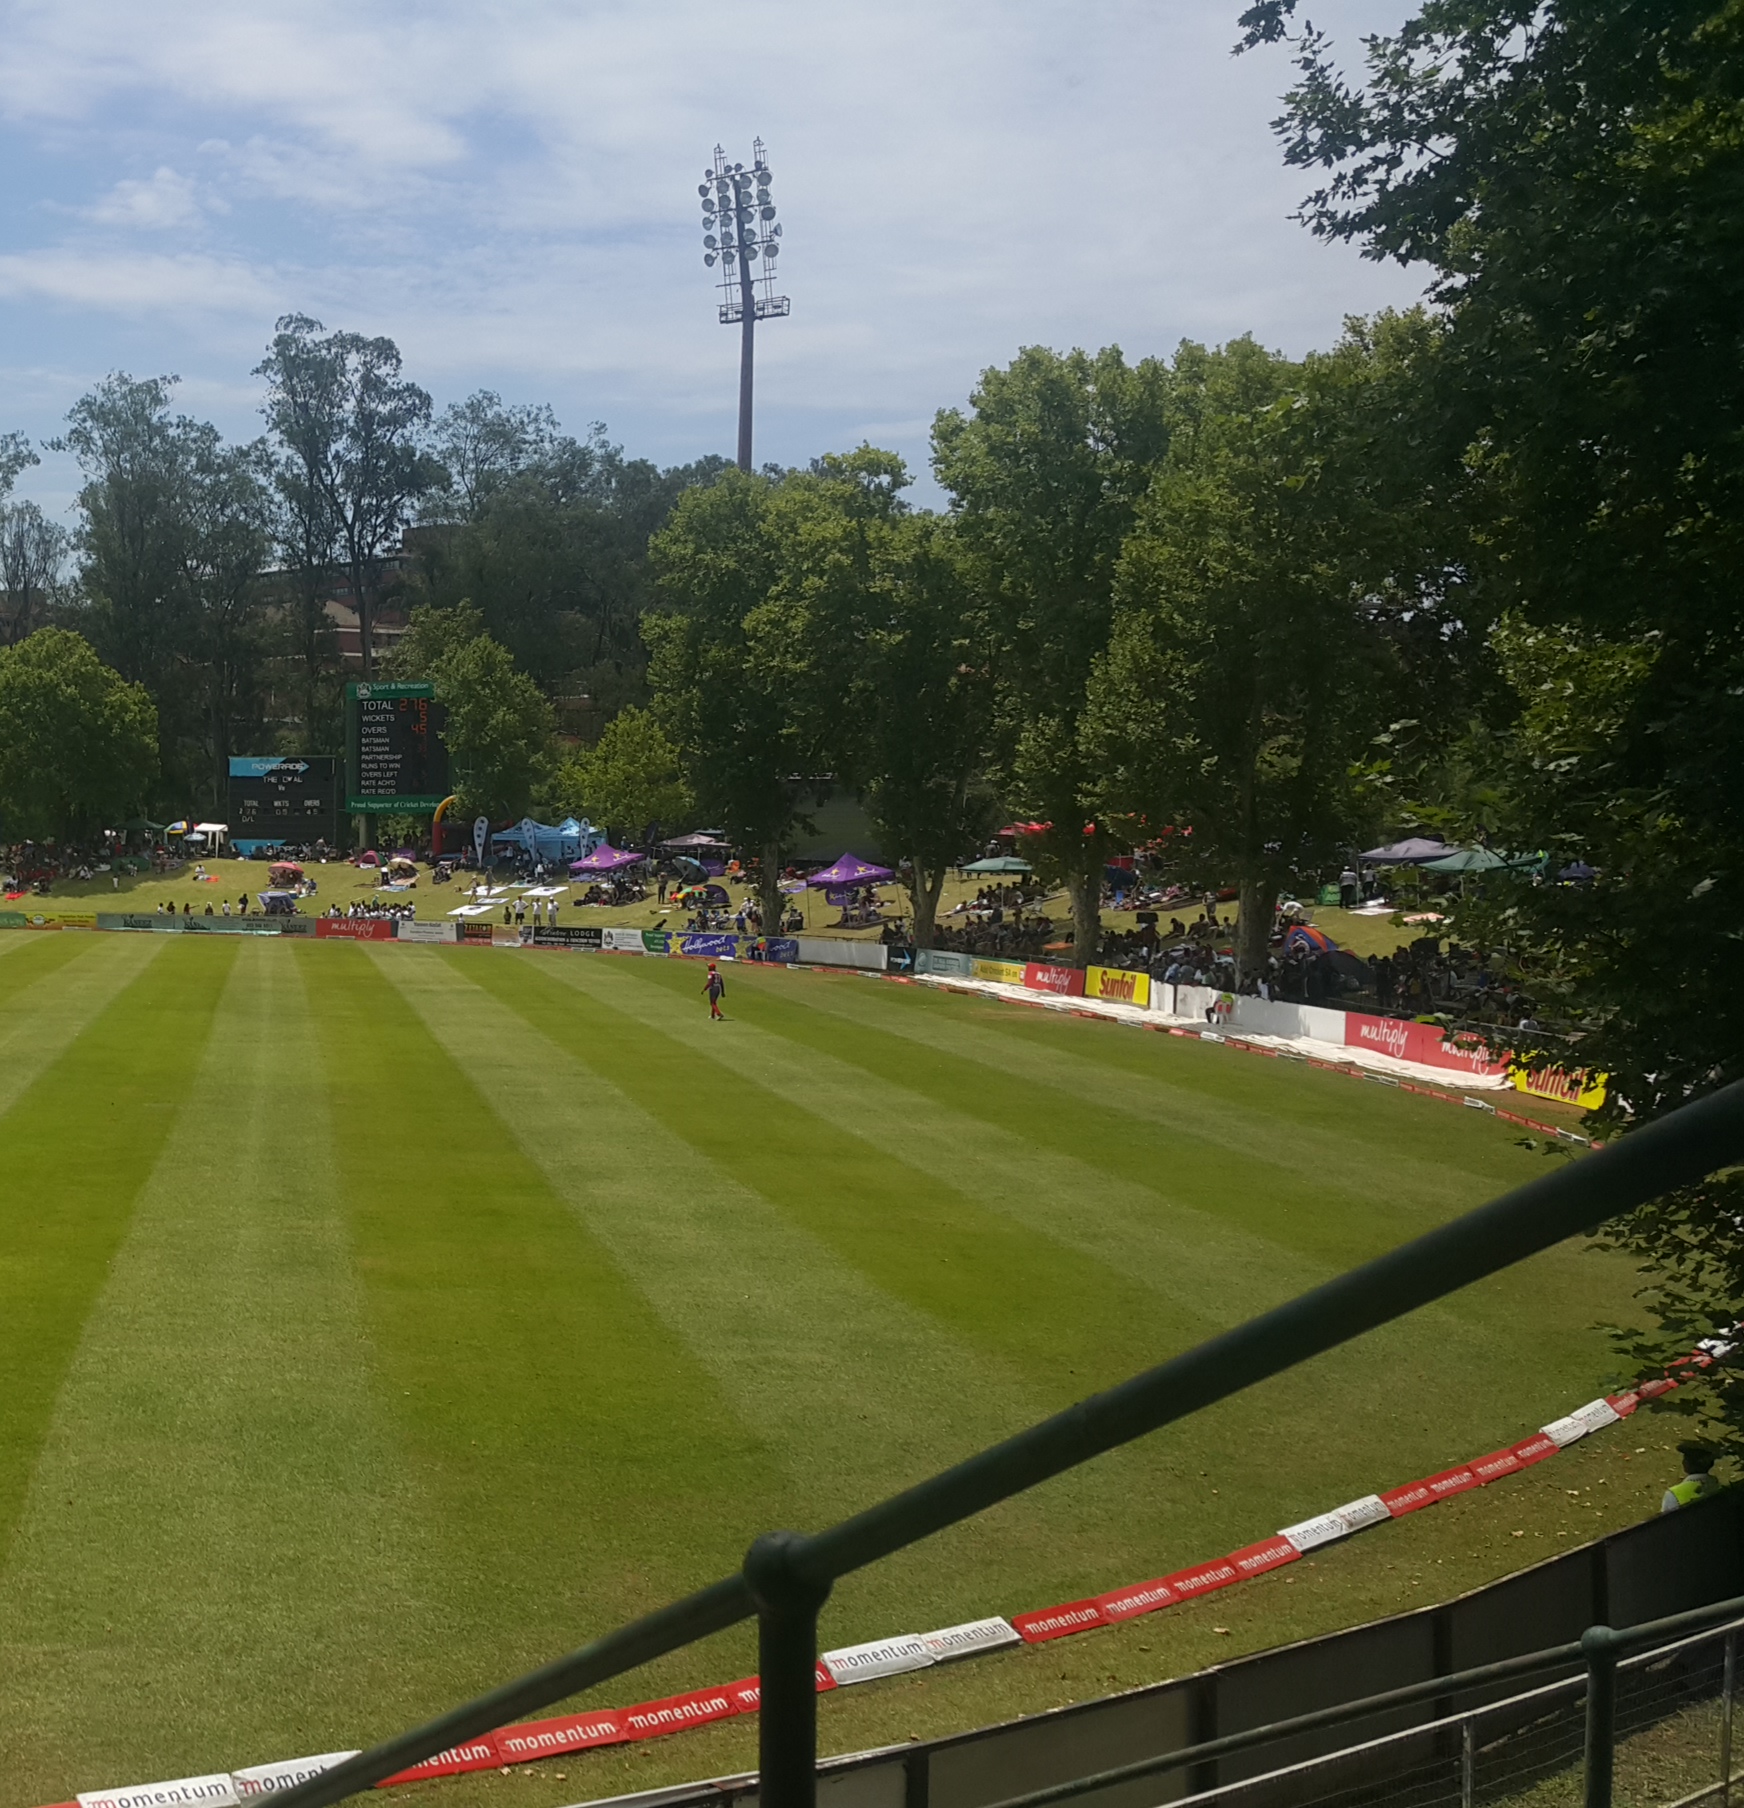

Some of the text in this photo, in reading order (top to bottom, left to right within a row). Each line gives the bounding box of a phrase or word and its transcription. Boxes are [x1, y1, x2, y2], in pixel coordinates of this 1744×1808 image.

[372, 683, 389, 691] Sport
[397, 682, 429, 690] Recreation
[361, 714, 396, 722] WICKETS
[362, 701, 394, 711] TOTAL
[361, 726, 387, 735] OVERS
[367, 801, 392, 809] Supporter
[330, 919, 375, 938] multiply
[569, 929, 596, 938] LODGE
[1035, 967, 1072, 996] multiply
[1099, 969, 1137, 1001] Sunfoil
[1360, 1020, 1409, 1058] multiply
[1476, 1453, 1519, 1477] momentum
[1429, 1471, 1474, 1494] momentum
[1387, 1486, 1430, 1511] momentum
[1238, 1542, 1293, 1572] momentum
[1174, 1564, 1236, 1593] momentum
[1105, 1586, 1172, 1616] momentum
[1024, 1605, 1100, 1636] momentum
[926, 1619, 1009, 1652] momentum
[830, 1639, 921, 1671] momentum
[627, 1694, 729, 1731] momentum
[505, 1718, 618, 1754] momentum
[86, 1781, 228, 1808] momentum
